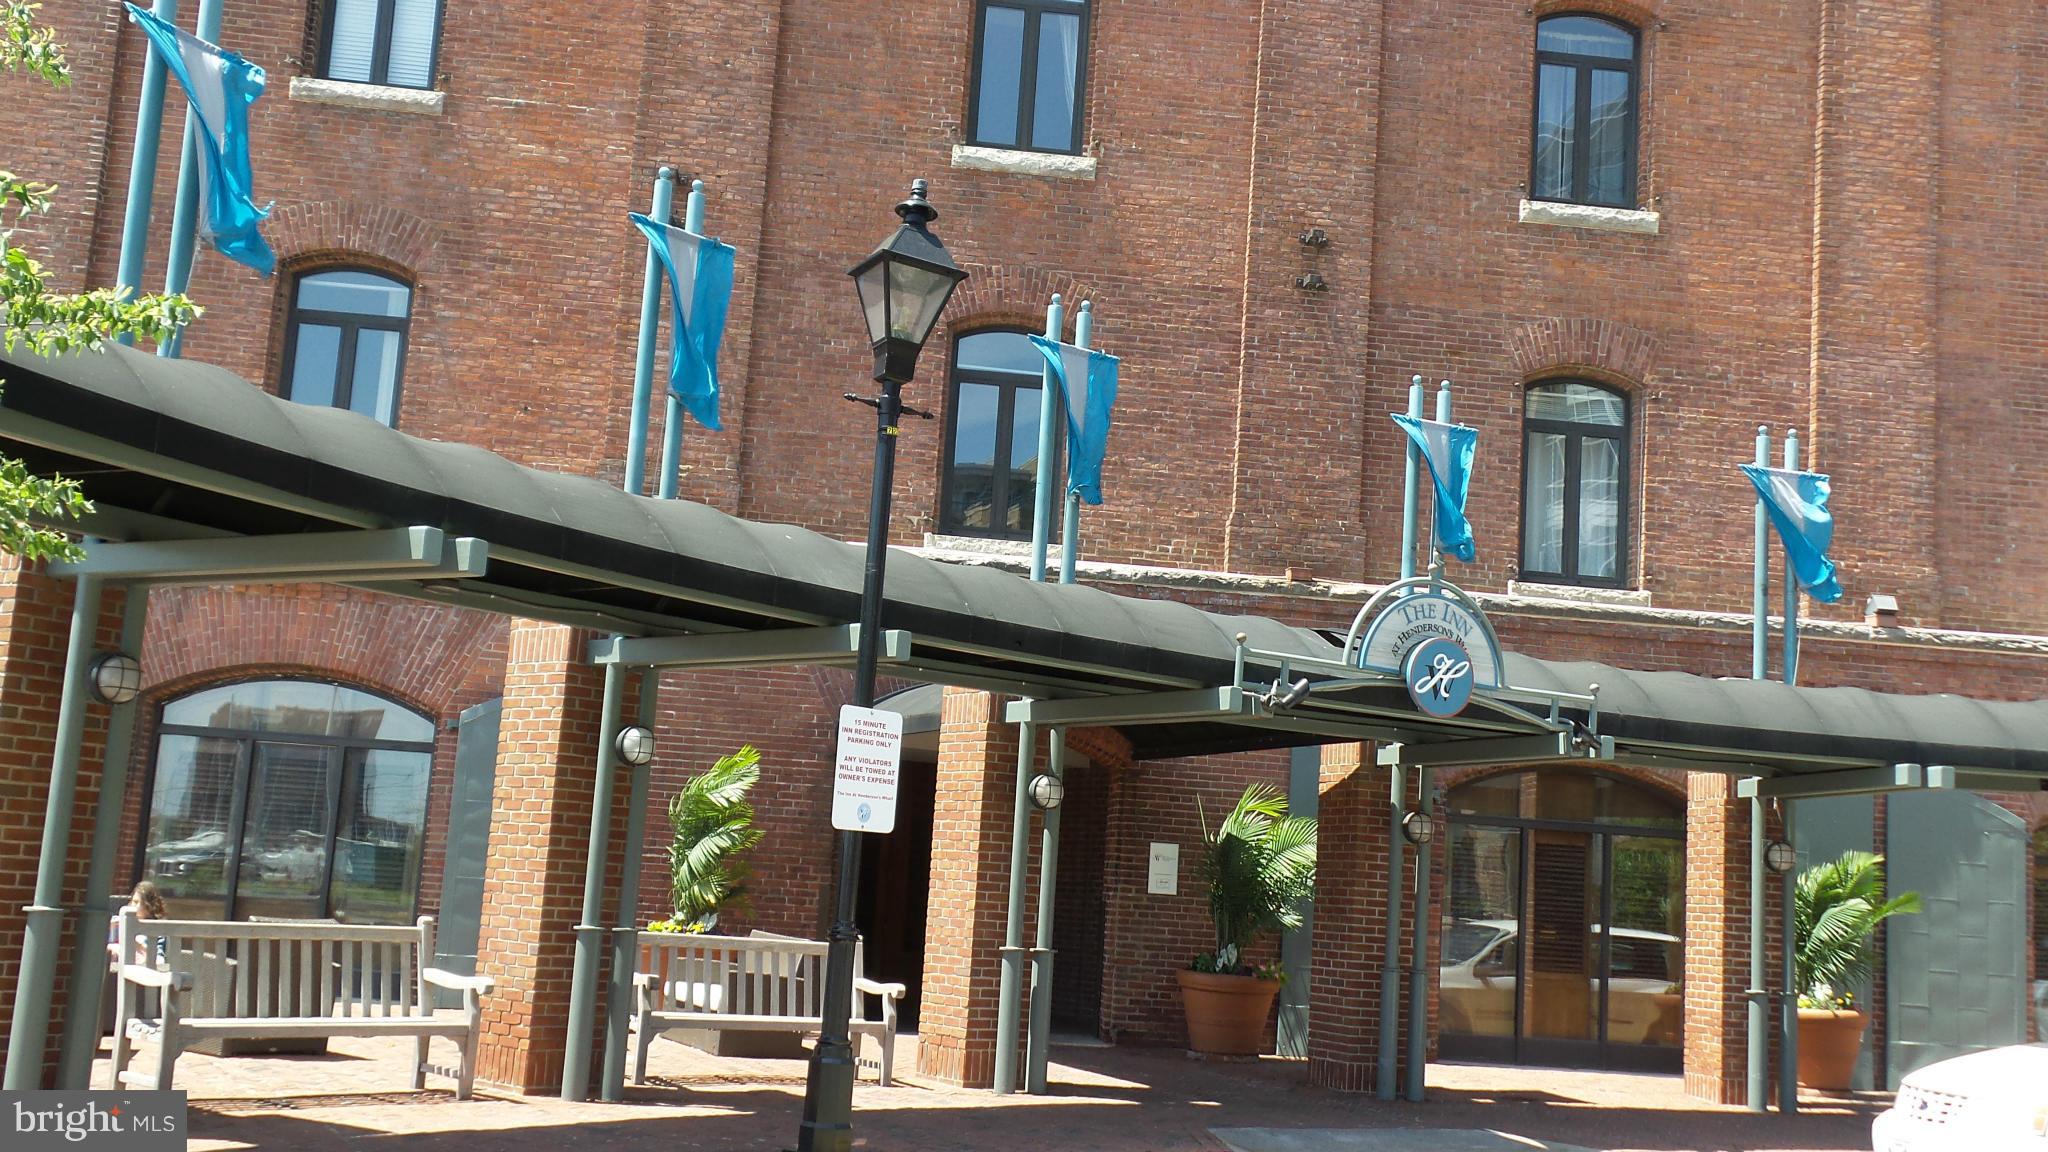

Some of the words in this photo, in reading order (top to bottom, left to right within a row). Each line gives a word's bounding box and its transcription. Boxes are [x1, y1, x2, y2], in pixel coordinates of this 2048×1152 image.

[1398, 603, 1437, 625] THE
[1442, 602, 1473, 637] INN
[1391, 642, 1401, 657] AT
[863, 721, 886, 730] MINUTE
[854, 728, 898, 740] REGISTRATION
[848, 736, 874, 746] PARKING
[859, 757, 892, 766] VIOLATORS
[865, 767, 886, 775] TOWED
[838, 773, 865, 782] OWNER'S
[867, 776, 894, 785] EXPENSE
